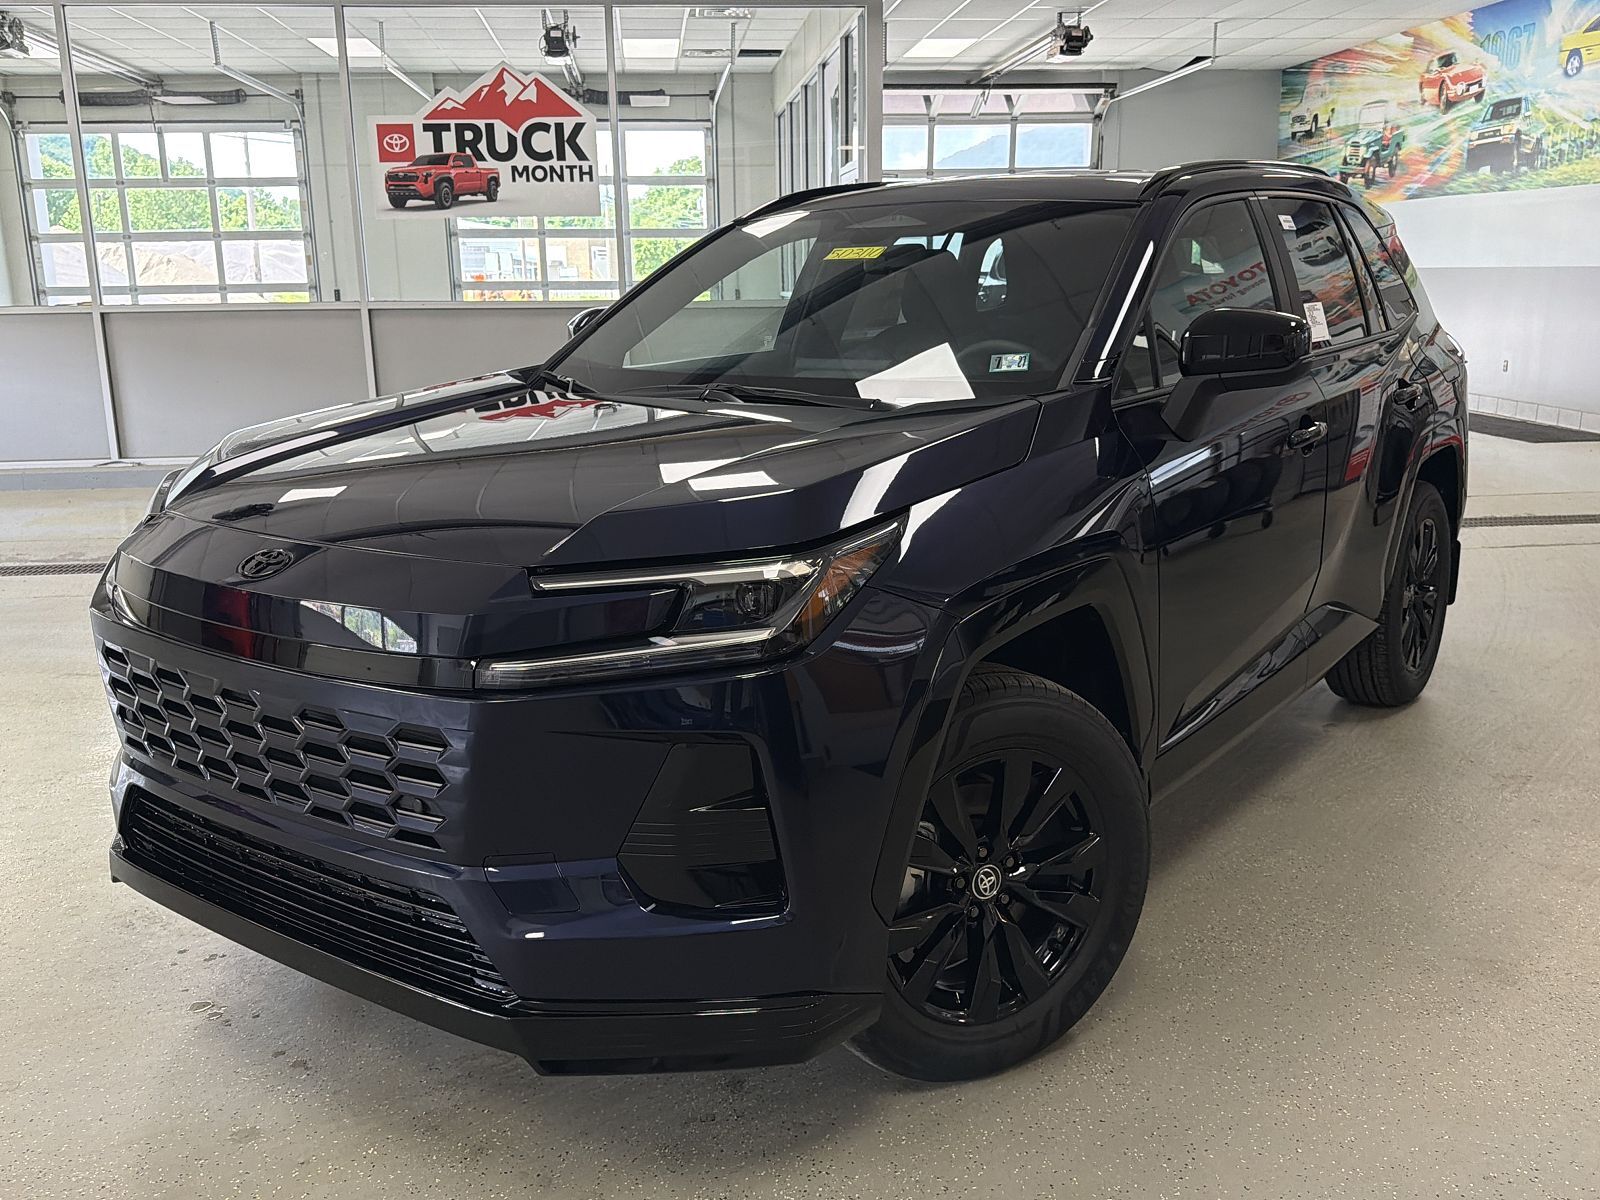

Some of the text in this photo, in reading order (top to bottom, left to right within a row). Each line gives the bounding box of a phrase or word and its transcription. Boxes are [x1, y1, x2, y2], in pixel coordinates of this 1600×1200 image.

[1480, 22, 1536, 71] 1967
[422, 122, 590, 162] TRUCK
[511, 164, 594, 183] MONTH
